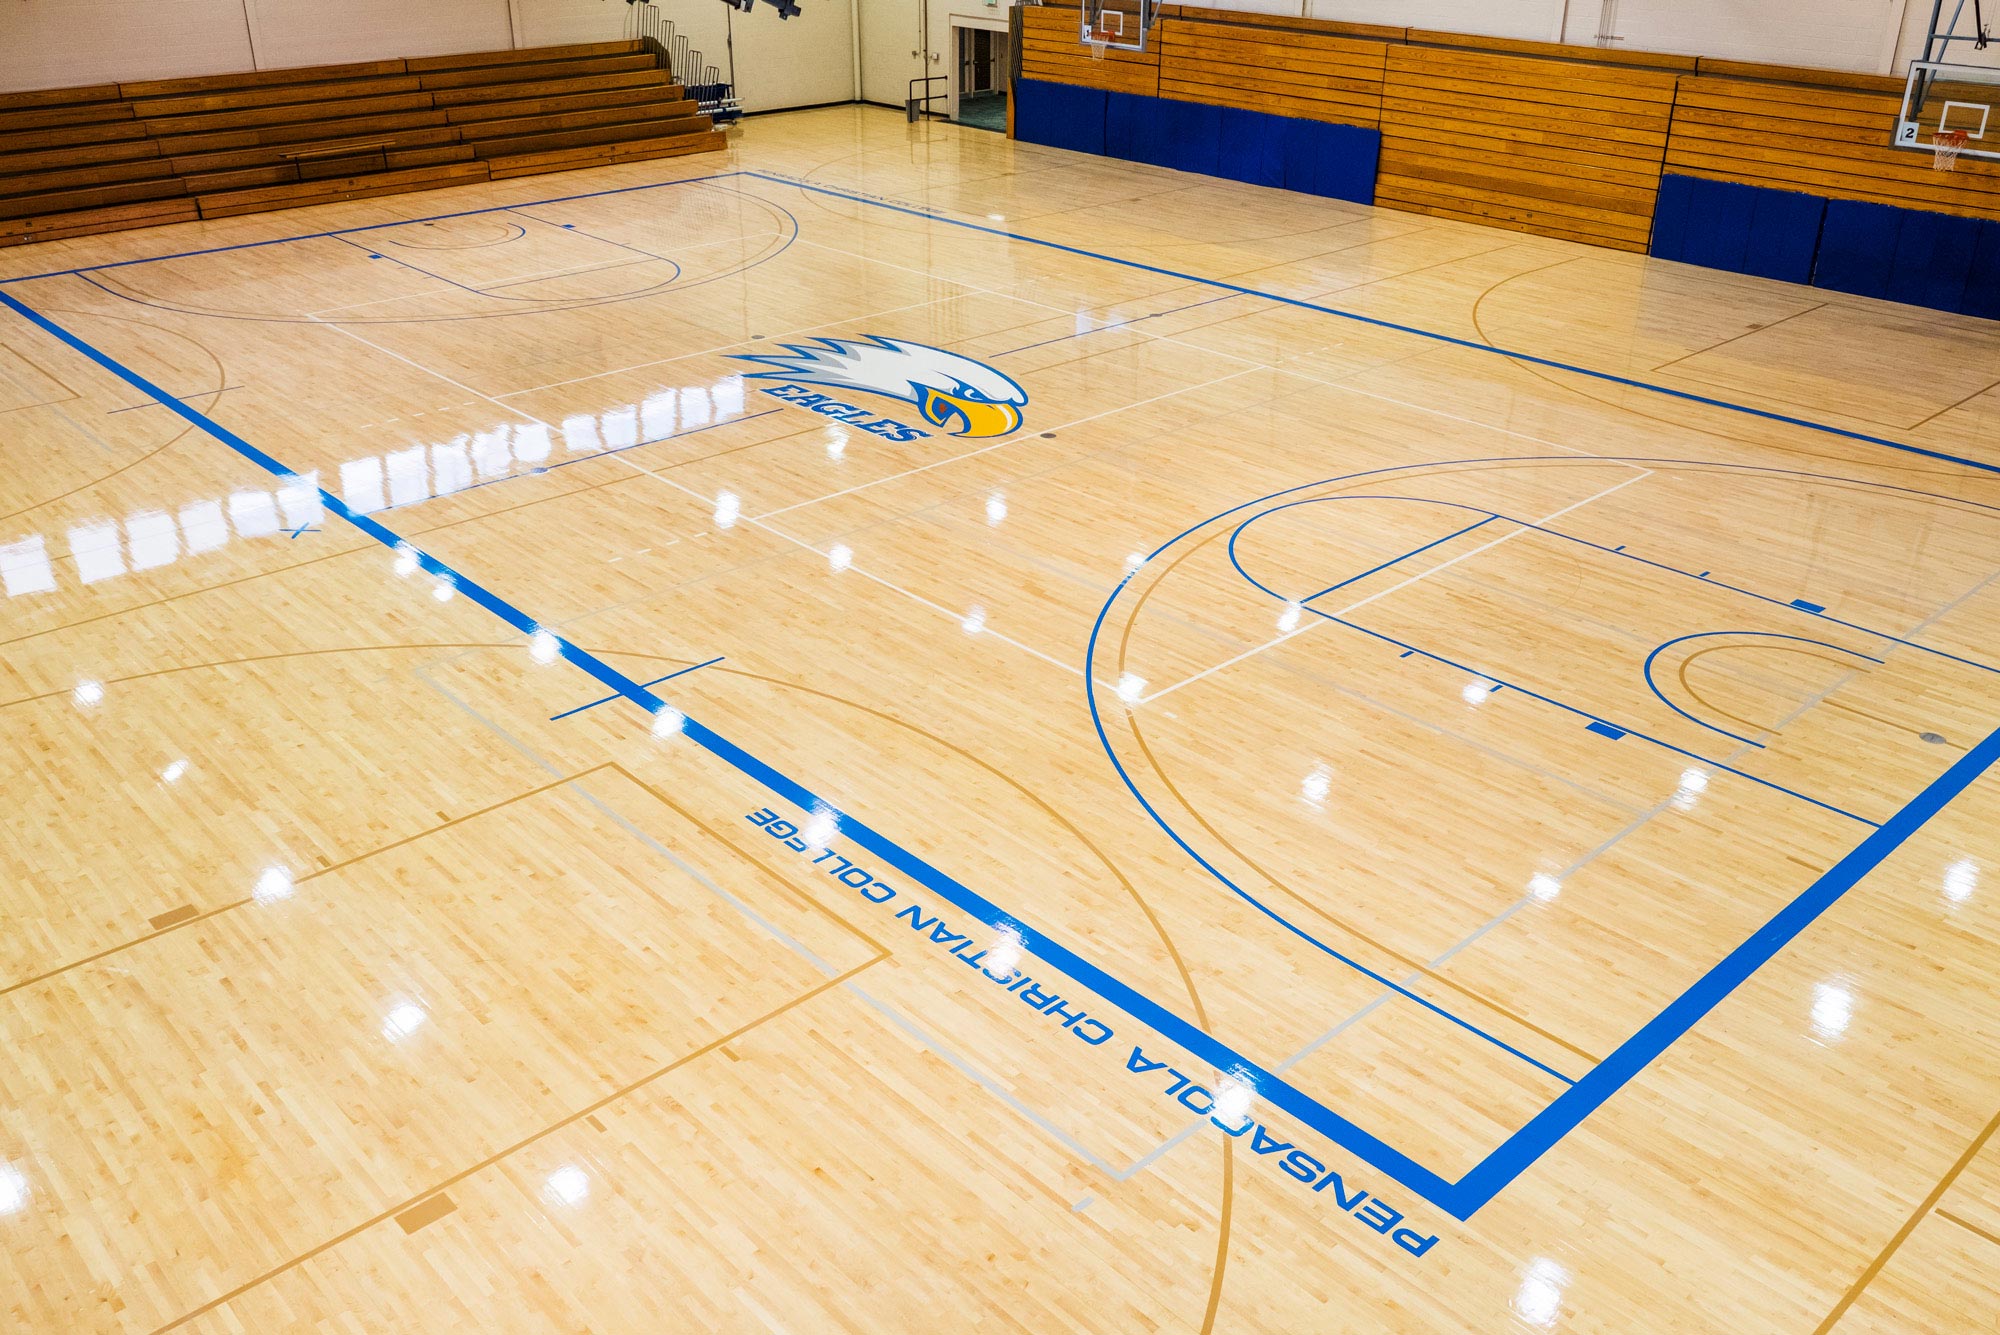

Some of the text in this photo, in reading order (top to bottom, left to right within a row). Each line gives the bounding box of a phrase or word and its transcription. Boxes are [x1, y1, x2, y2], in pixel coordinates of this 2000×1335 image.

[1905, 127, 1915, 139] 2
[759, 384, 935, 442] EAGLES
[1126, 1046, 1440, 1258] PENSACOLA
